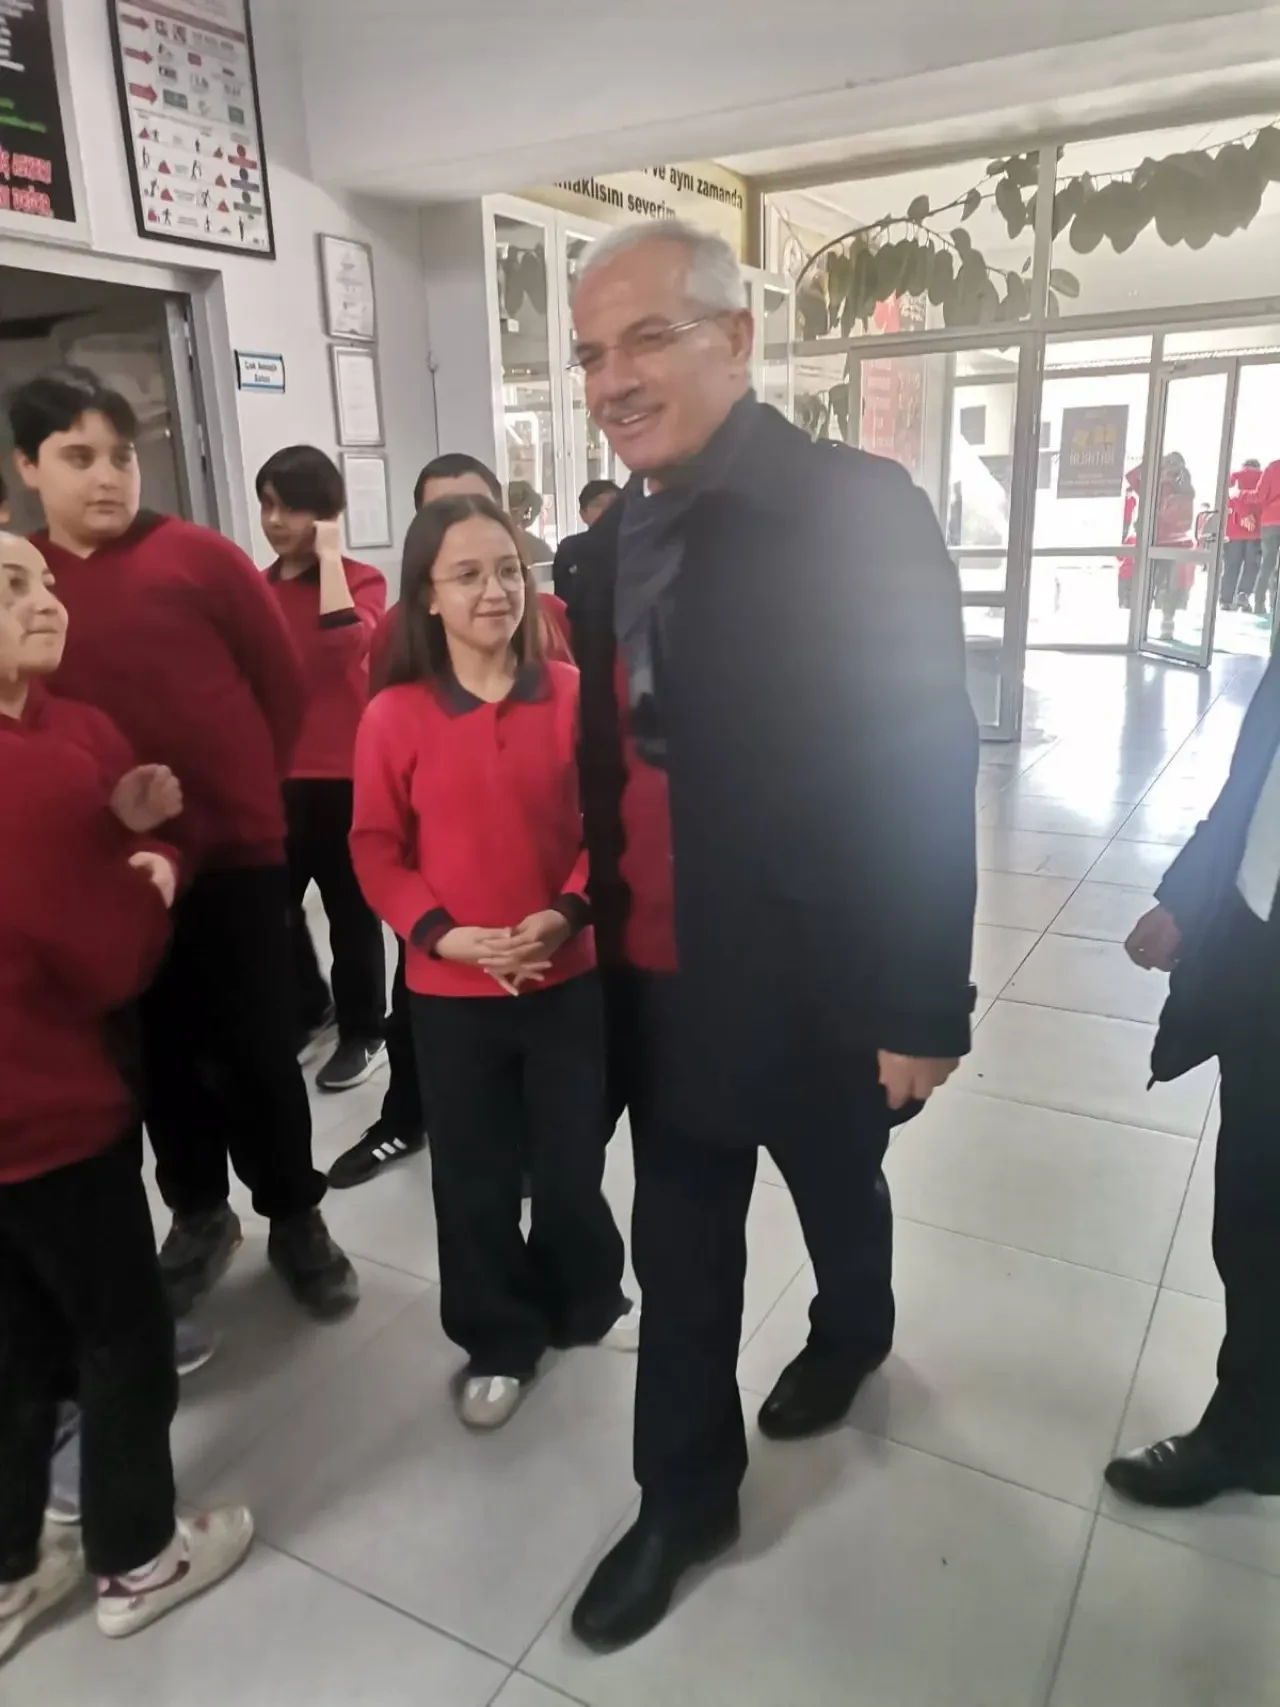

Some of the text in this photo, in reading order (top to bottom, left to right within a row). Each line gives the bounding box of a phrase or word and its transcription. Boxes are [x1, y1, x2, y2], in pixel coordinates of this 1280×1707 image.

[670, 167, 693, 192] aynı
[697, 178, 743, 209] zamanda
[628, 193, 677, 220] severim
